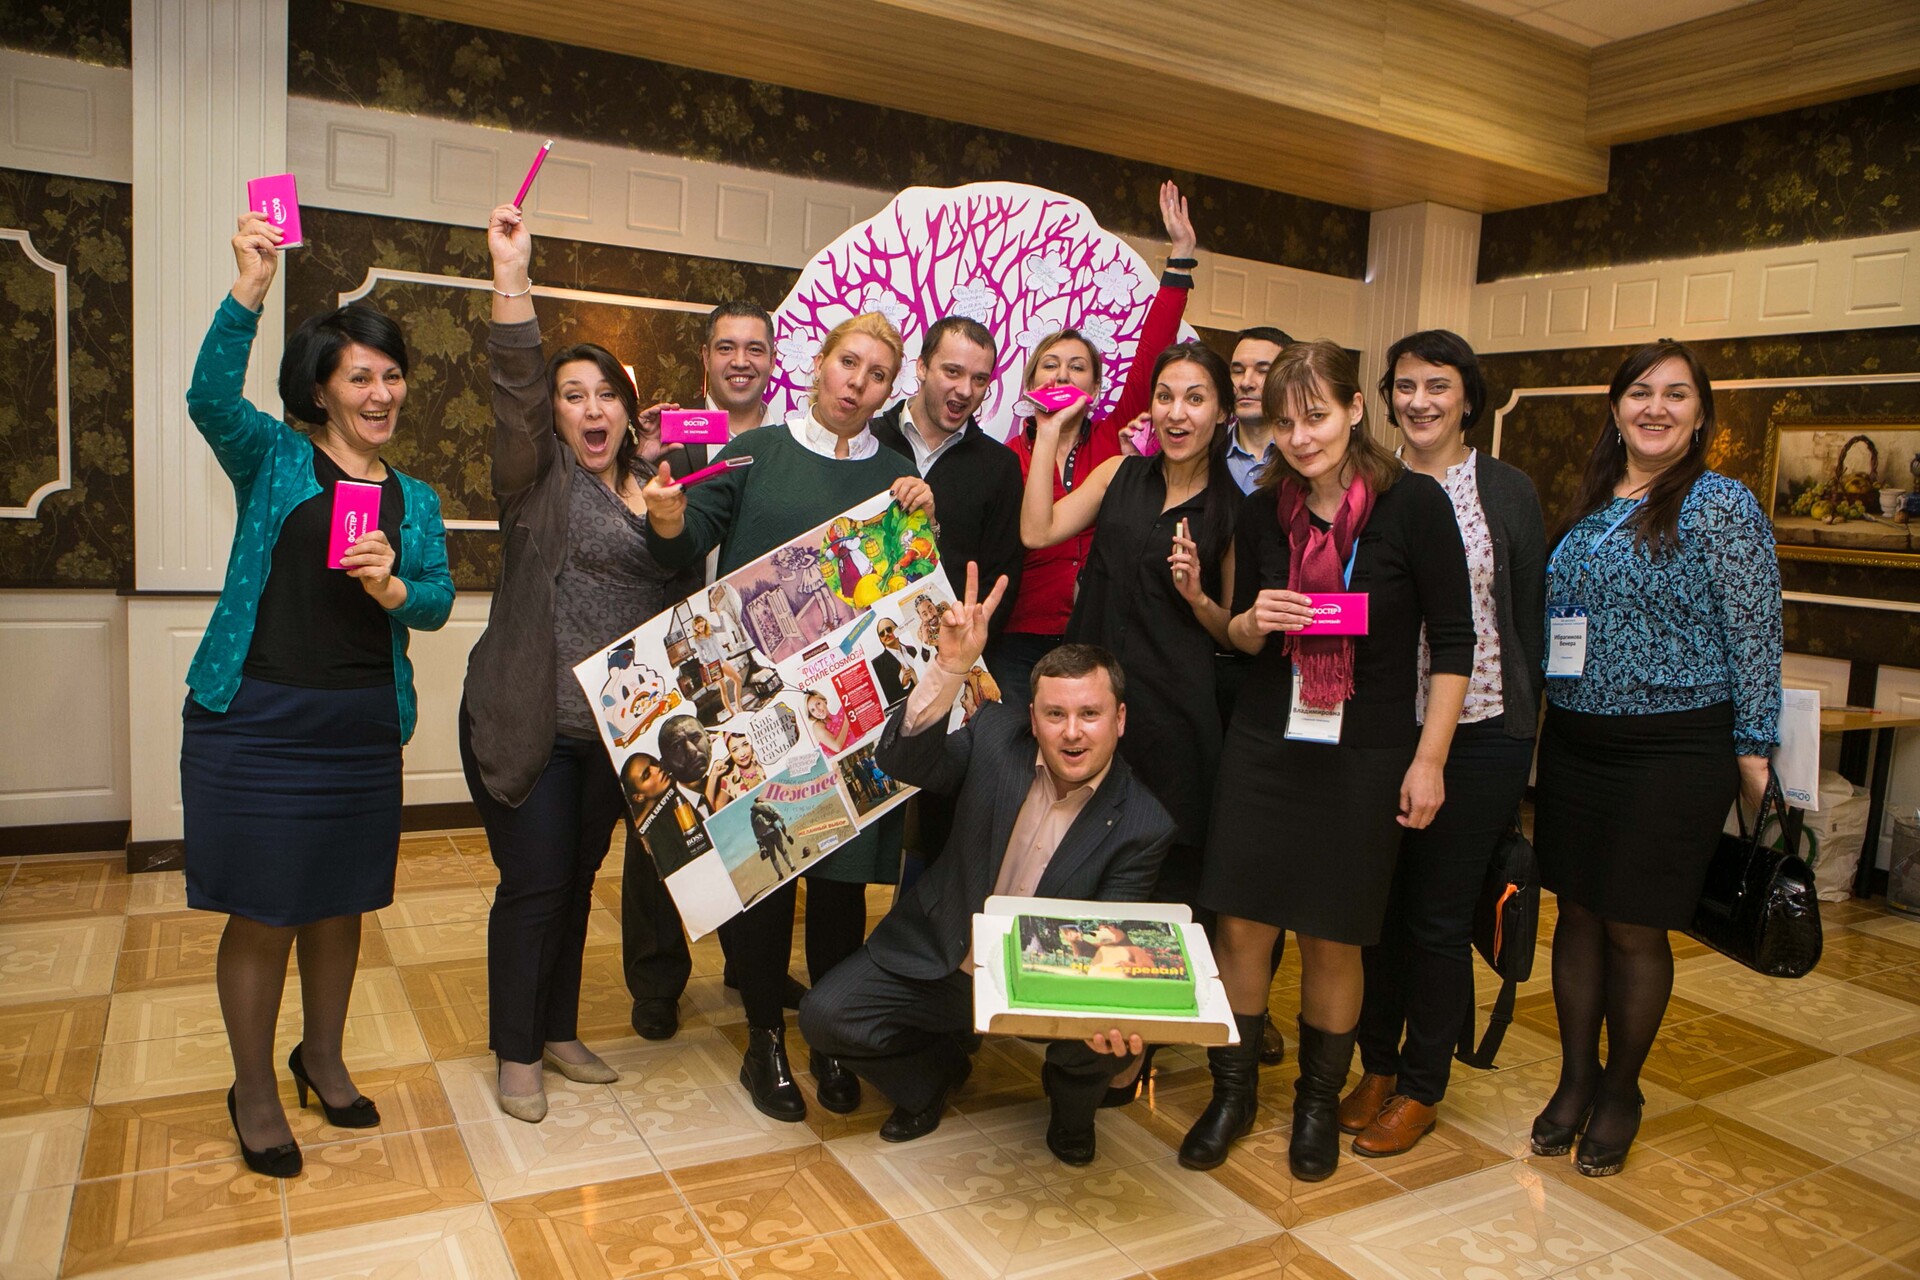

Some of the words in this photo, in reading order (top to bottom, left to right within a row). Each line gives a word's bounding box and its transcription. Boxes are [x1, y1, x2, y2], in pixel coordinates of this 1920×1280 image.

[347, 512, 357, 543] ФОСТЕР
[801, 653, 836, 677] ФОСТЕР
[798, 682, 805, 691] В
[804, 668, 830, 688] СТИЛЕ
[835, 677, 843, 689] 1
[841, 694, 851, 707] 2
[848, 710, 857, 722] 3
[1293, 707, 1341, 717] Владимировна
[750, 714, 773, 732] Как
[653, 803, 664, 816] КАК
[686, 833, 704, 847] BOSS
